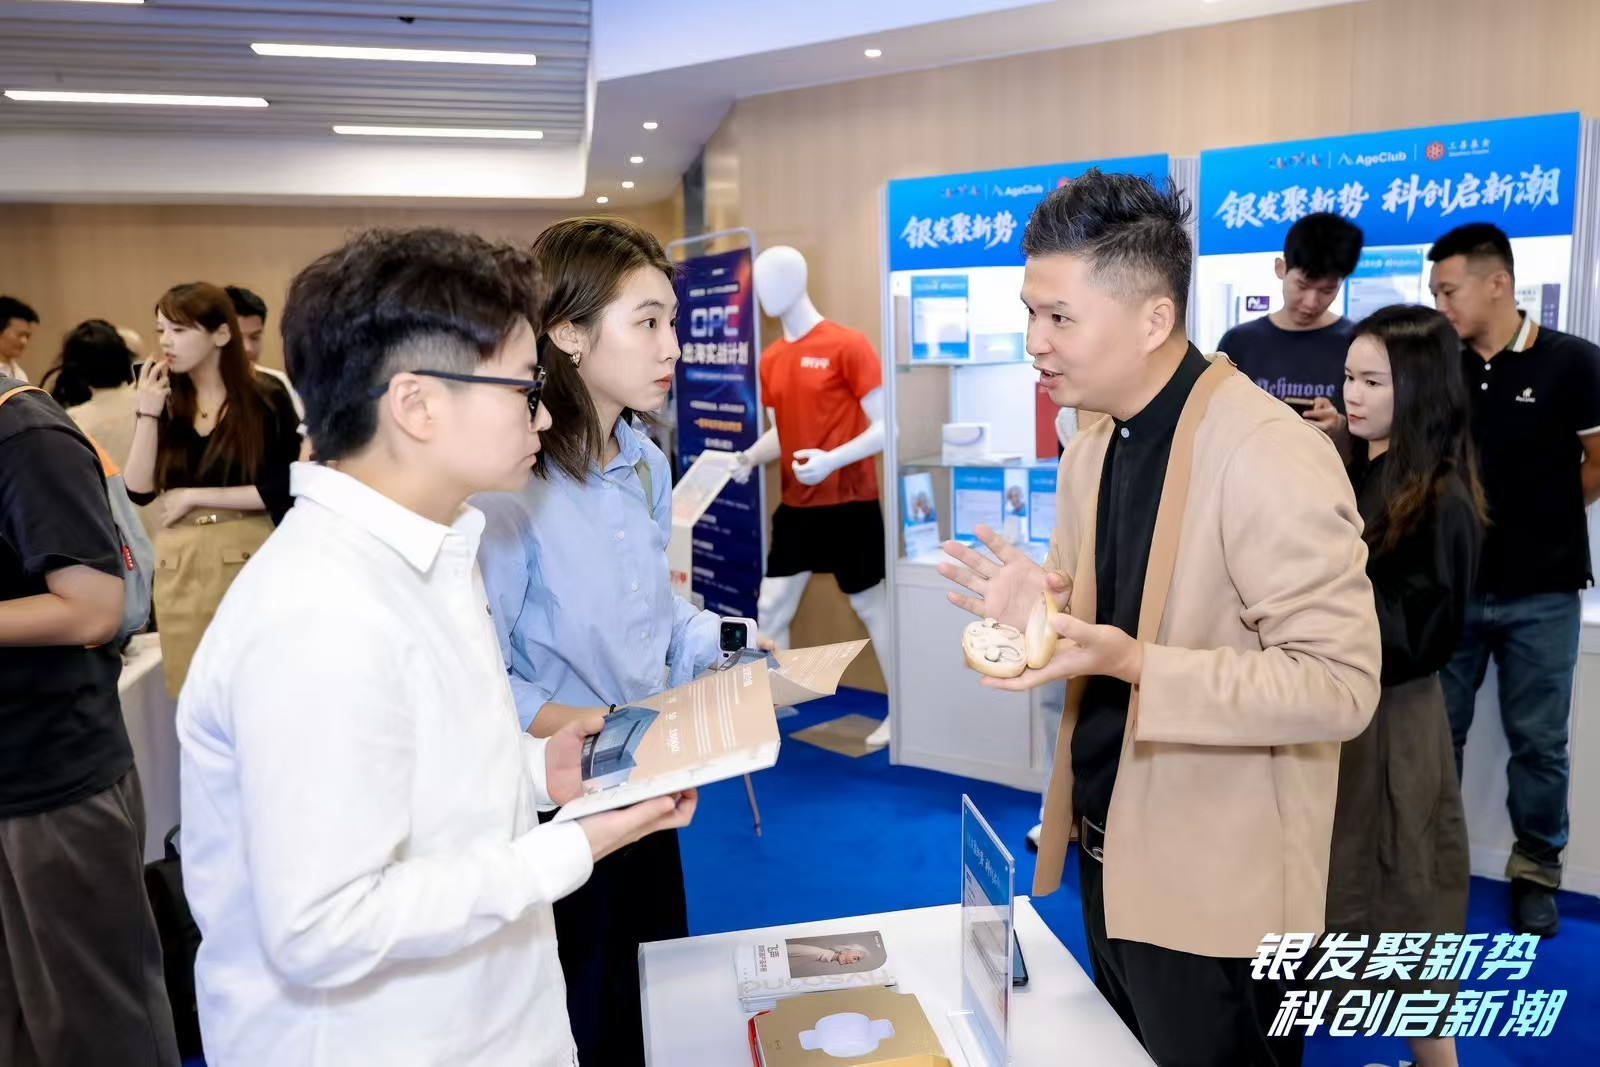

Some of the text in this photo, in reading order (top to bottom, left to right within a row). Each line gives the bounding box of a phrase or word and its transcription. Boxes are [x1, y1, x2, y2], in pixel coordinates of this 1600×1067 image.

[1355, 151, 1407, 167] AgeClub
[1004, 184, 1044, 198] AgeClub
[1215, 163, 1562, 229] 银发聚新势 科创启新潮
[900, 210, 1018, 250] 银发聚新势
[690, 305, 740, 337] OPC
